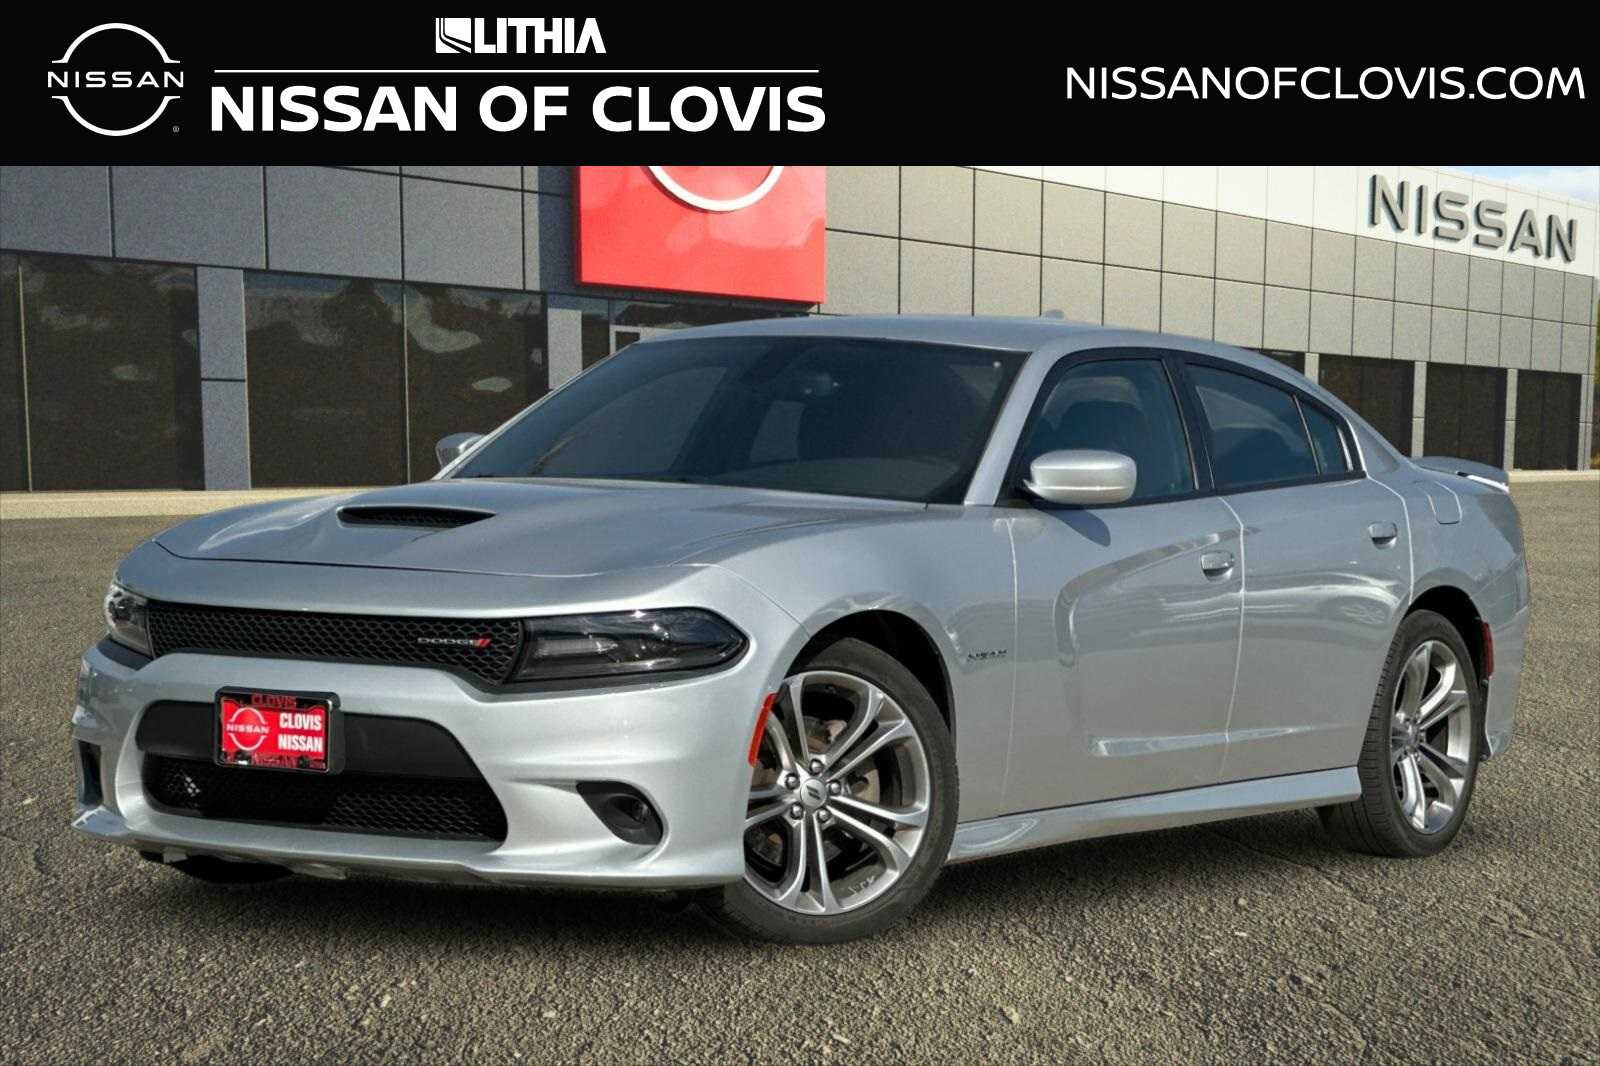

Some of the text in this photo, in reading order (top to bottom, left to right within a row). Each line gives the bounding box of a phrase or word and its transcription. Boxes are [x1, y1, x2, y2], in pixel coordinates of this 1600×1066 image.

[1369, 174, 1578, 263] NISSAN
[225, 722, 271, 735] NISSAN
[279, 712, 322, 731] CLOVIS
[277, 733, 323, 753] NISSAN
